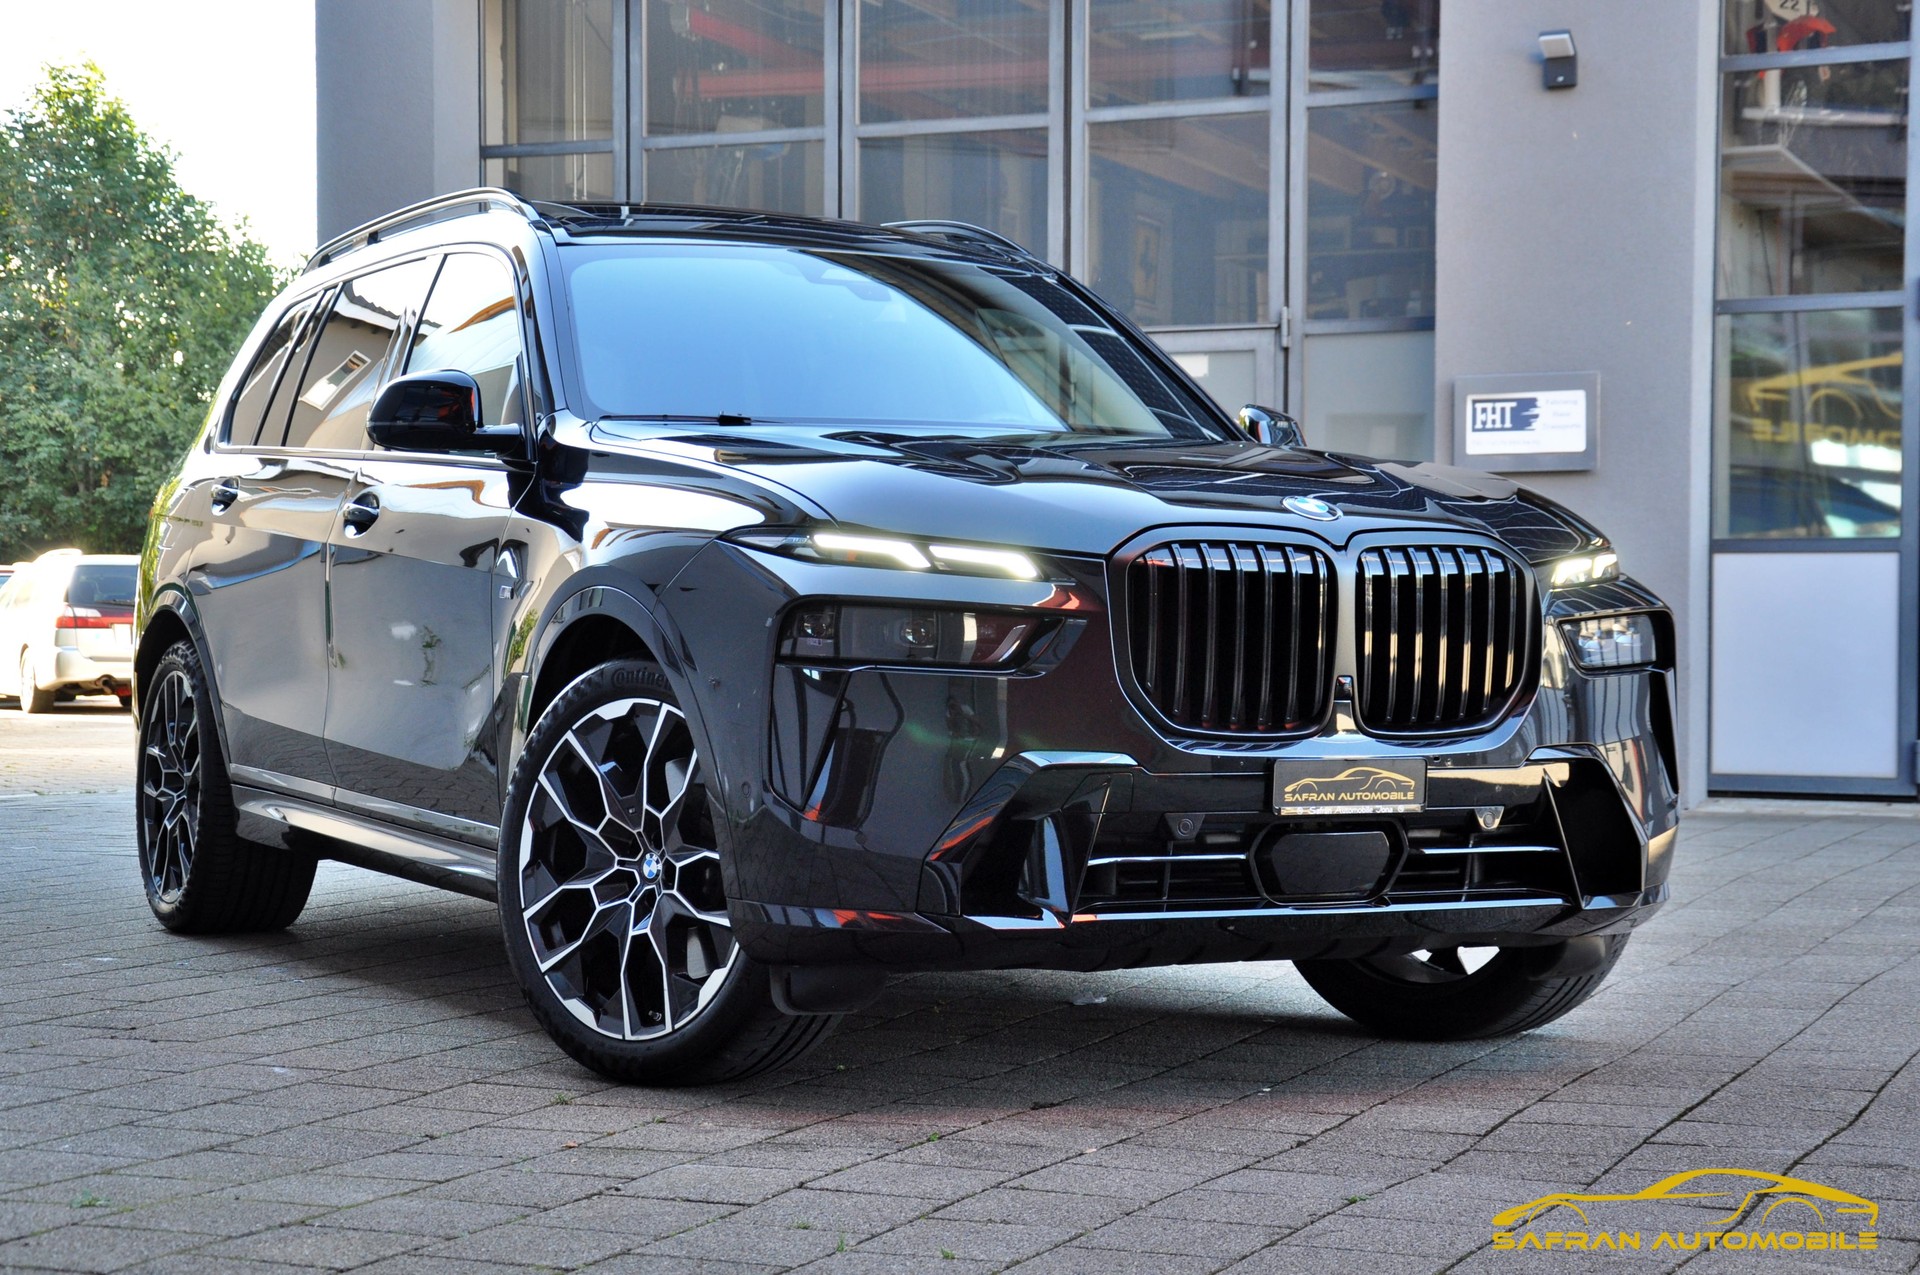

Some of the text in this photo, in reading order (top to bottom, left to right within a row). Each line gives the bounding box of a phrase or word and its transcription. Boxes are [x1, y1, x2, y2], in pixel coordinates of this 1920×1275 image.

[1474, 402, 1517, 429] FHT
[1284, 791, 1415, 802] SAFRAN AUTOMOBILE
[1309, 806, 1332, 814] Safran
[1334, 805, 1373, 814] Automobile
